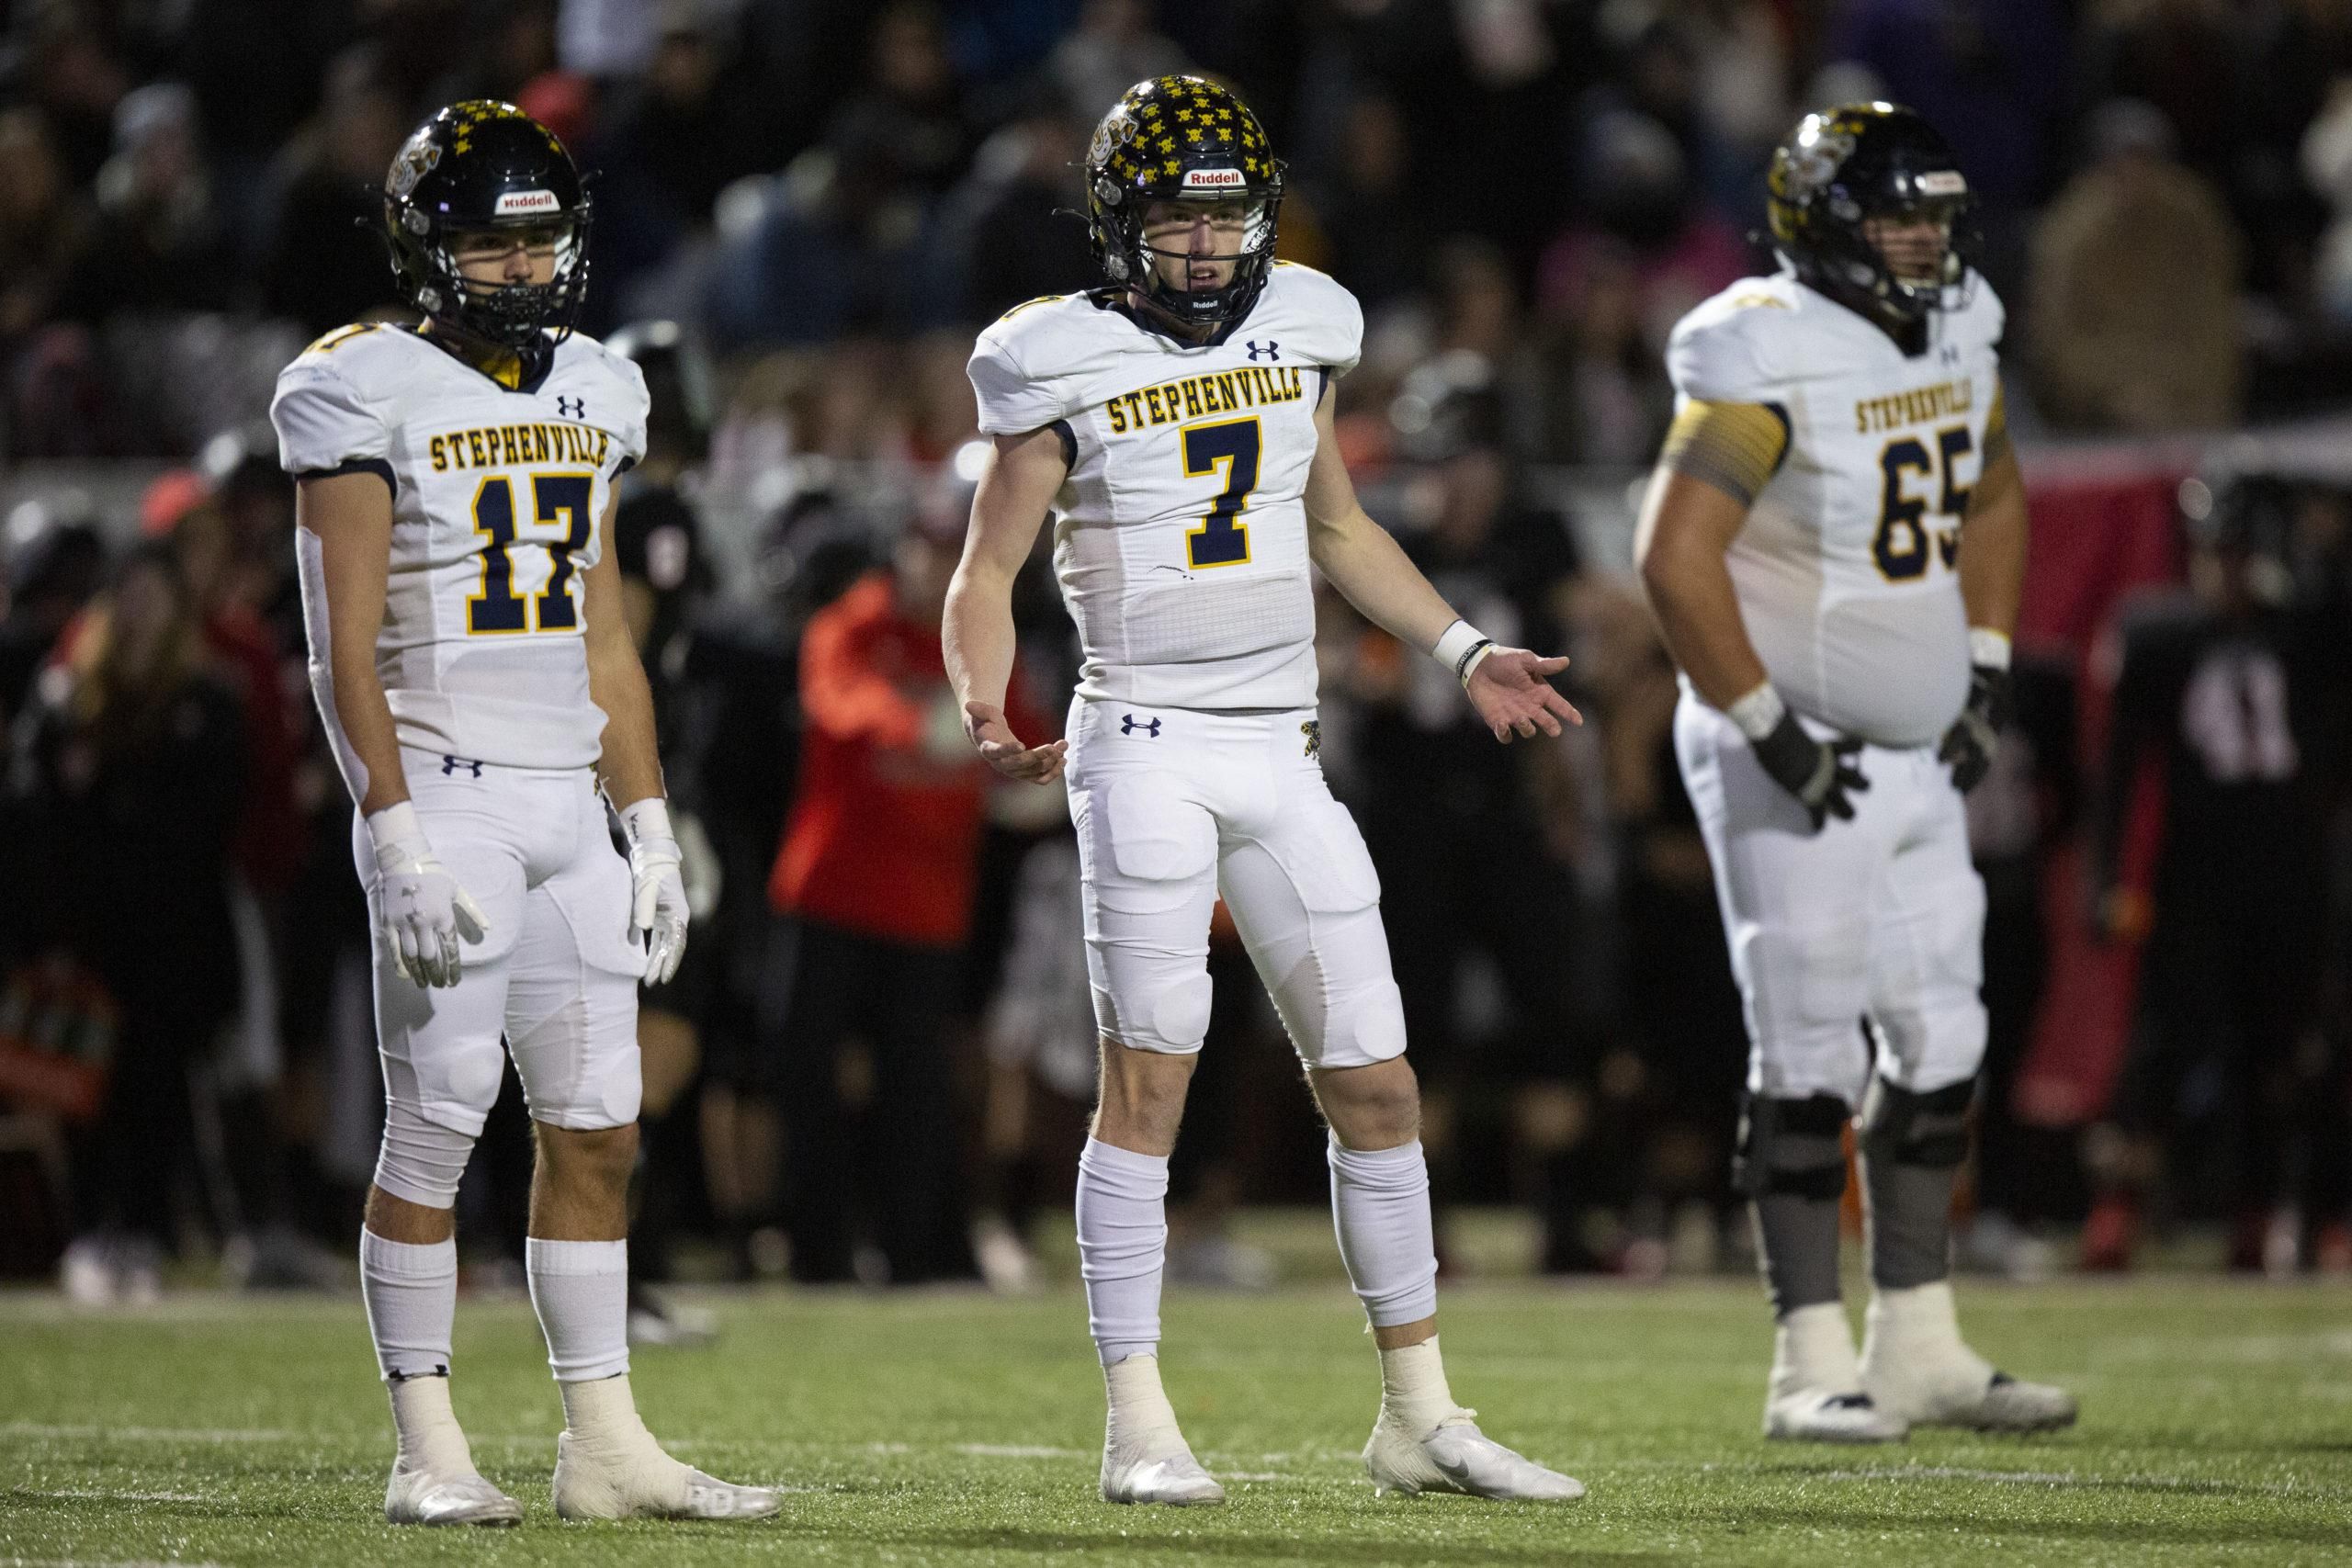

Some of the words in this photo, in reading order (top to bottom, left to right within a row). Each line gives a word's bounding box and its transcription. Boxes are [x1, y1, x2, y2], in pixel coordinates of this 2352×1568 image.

[503, 194, 552, 208] Riddell
[1191, 173, 1238, 184] Riddell
[1193, 299, 1218, 309] Riddell
[1106, 367, 1302, 434] STEPHENVILLE
[429, 423, 609, 472] STEPHENVILLE
[1179, 414, 1263, 570] 7
[1871, 425, 1973, 582] 65
[466, 471, 594, 636] 17
